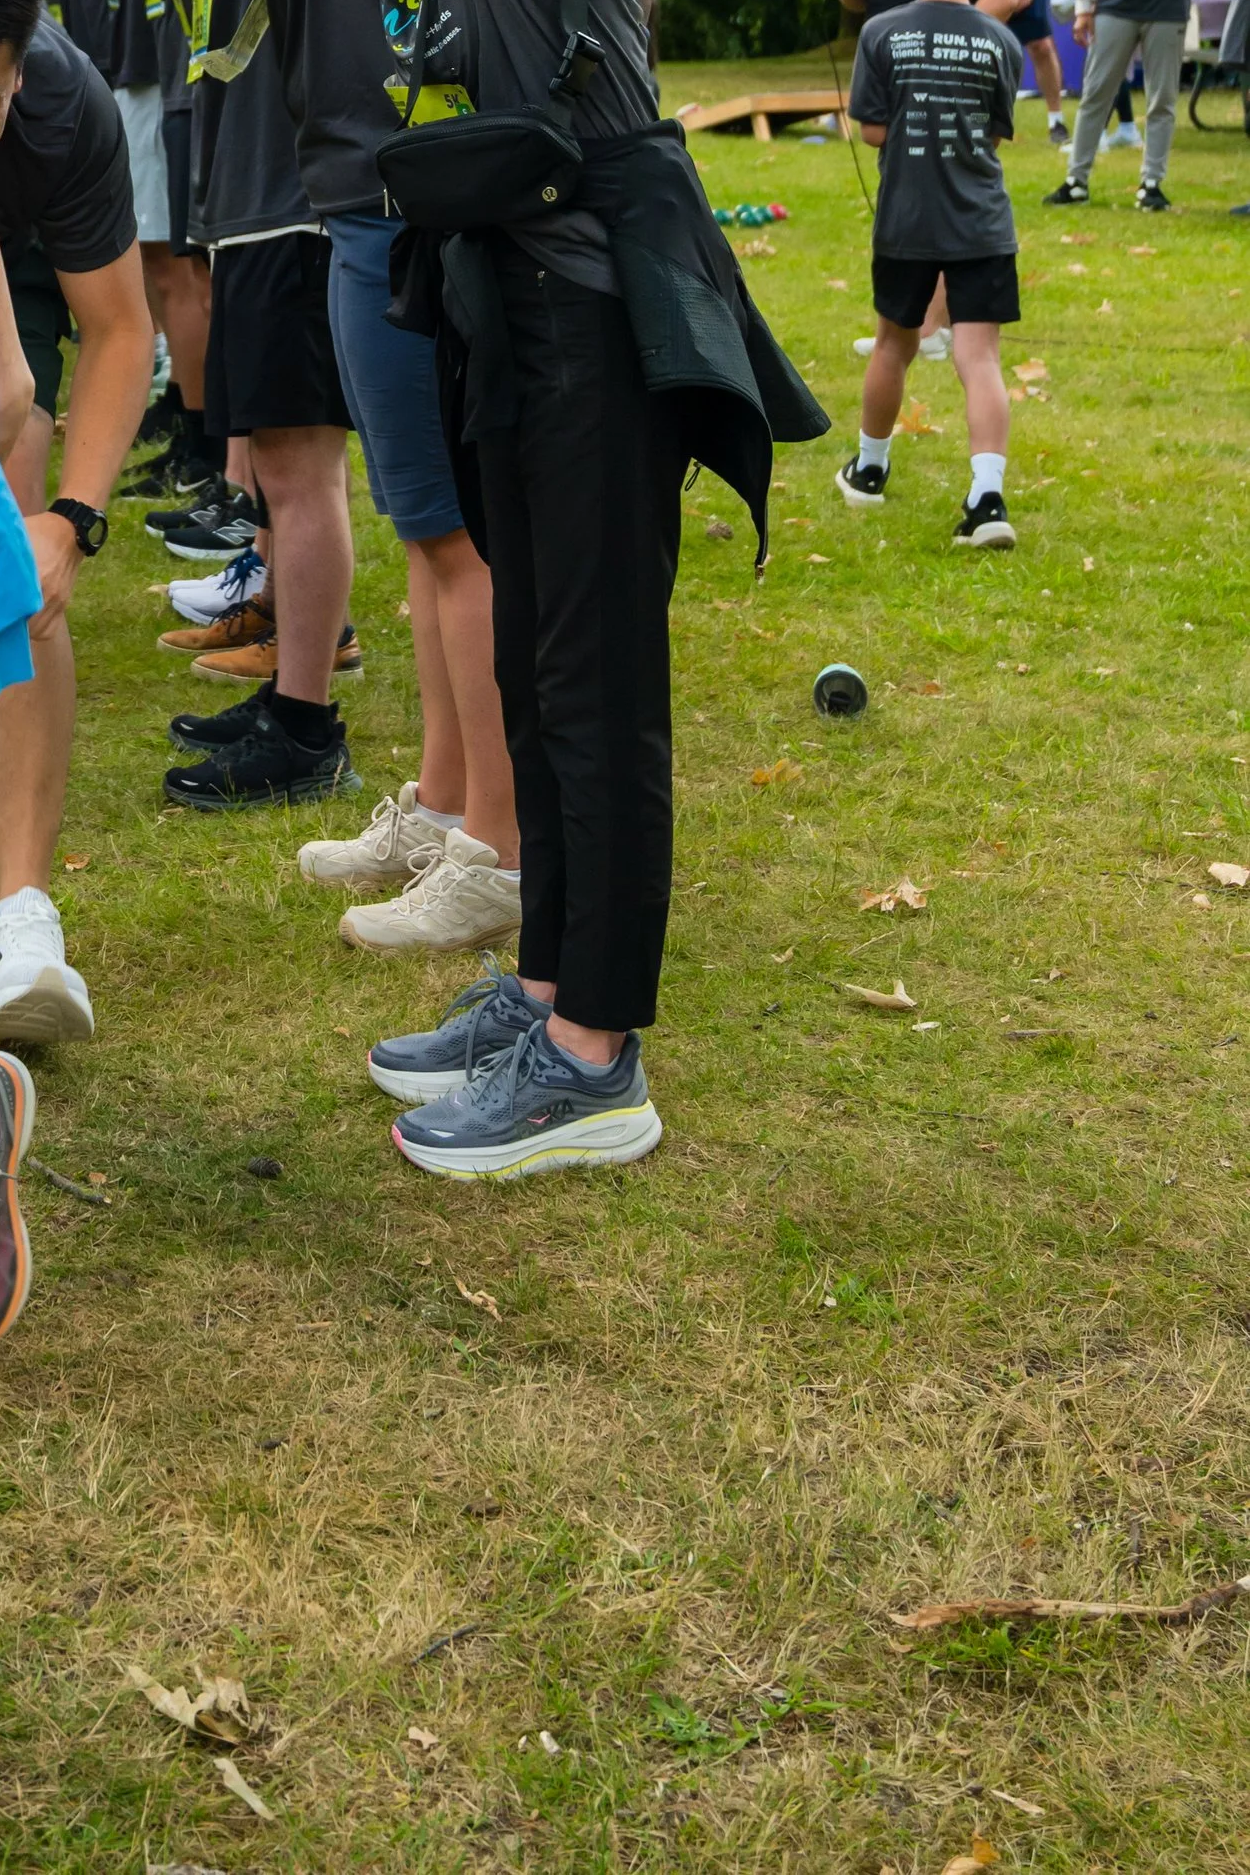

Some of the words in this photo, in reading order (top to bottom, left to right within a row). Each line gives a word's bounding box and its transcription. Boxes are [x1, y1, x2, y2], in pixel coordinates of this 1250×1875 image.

[932, 33, 968, 47] RUN.
[892, 47, 926, 60] friends
[932, 47, 969, 62] STEP
[972, 51, 992, 65] UP.
